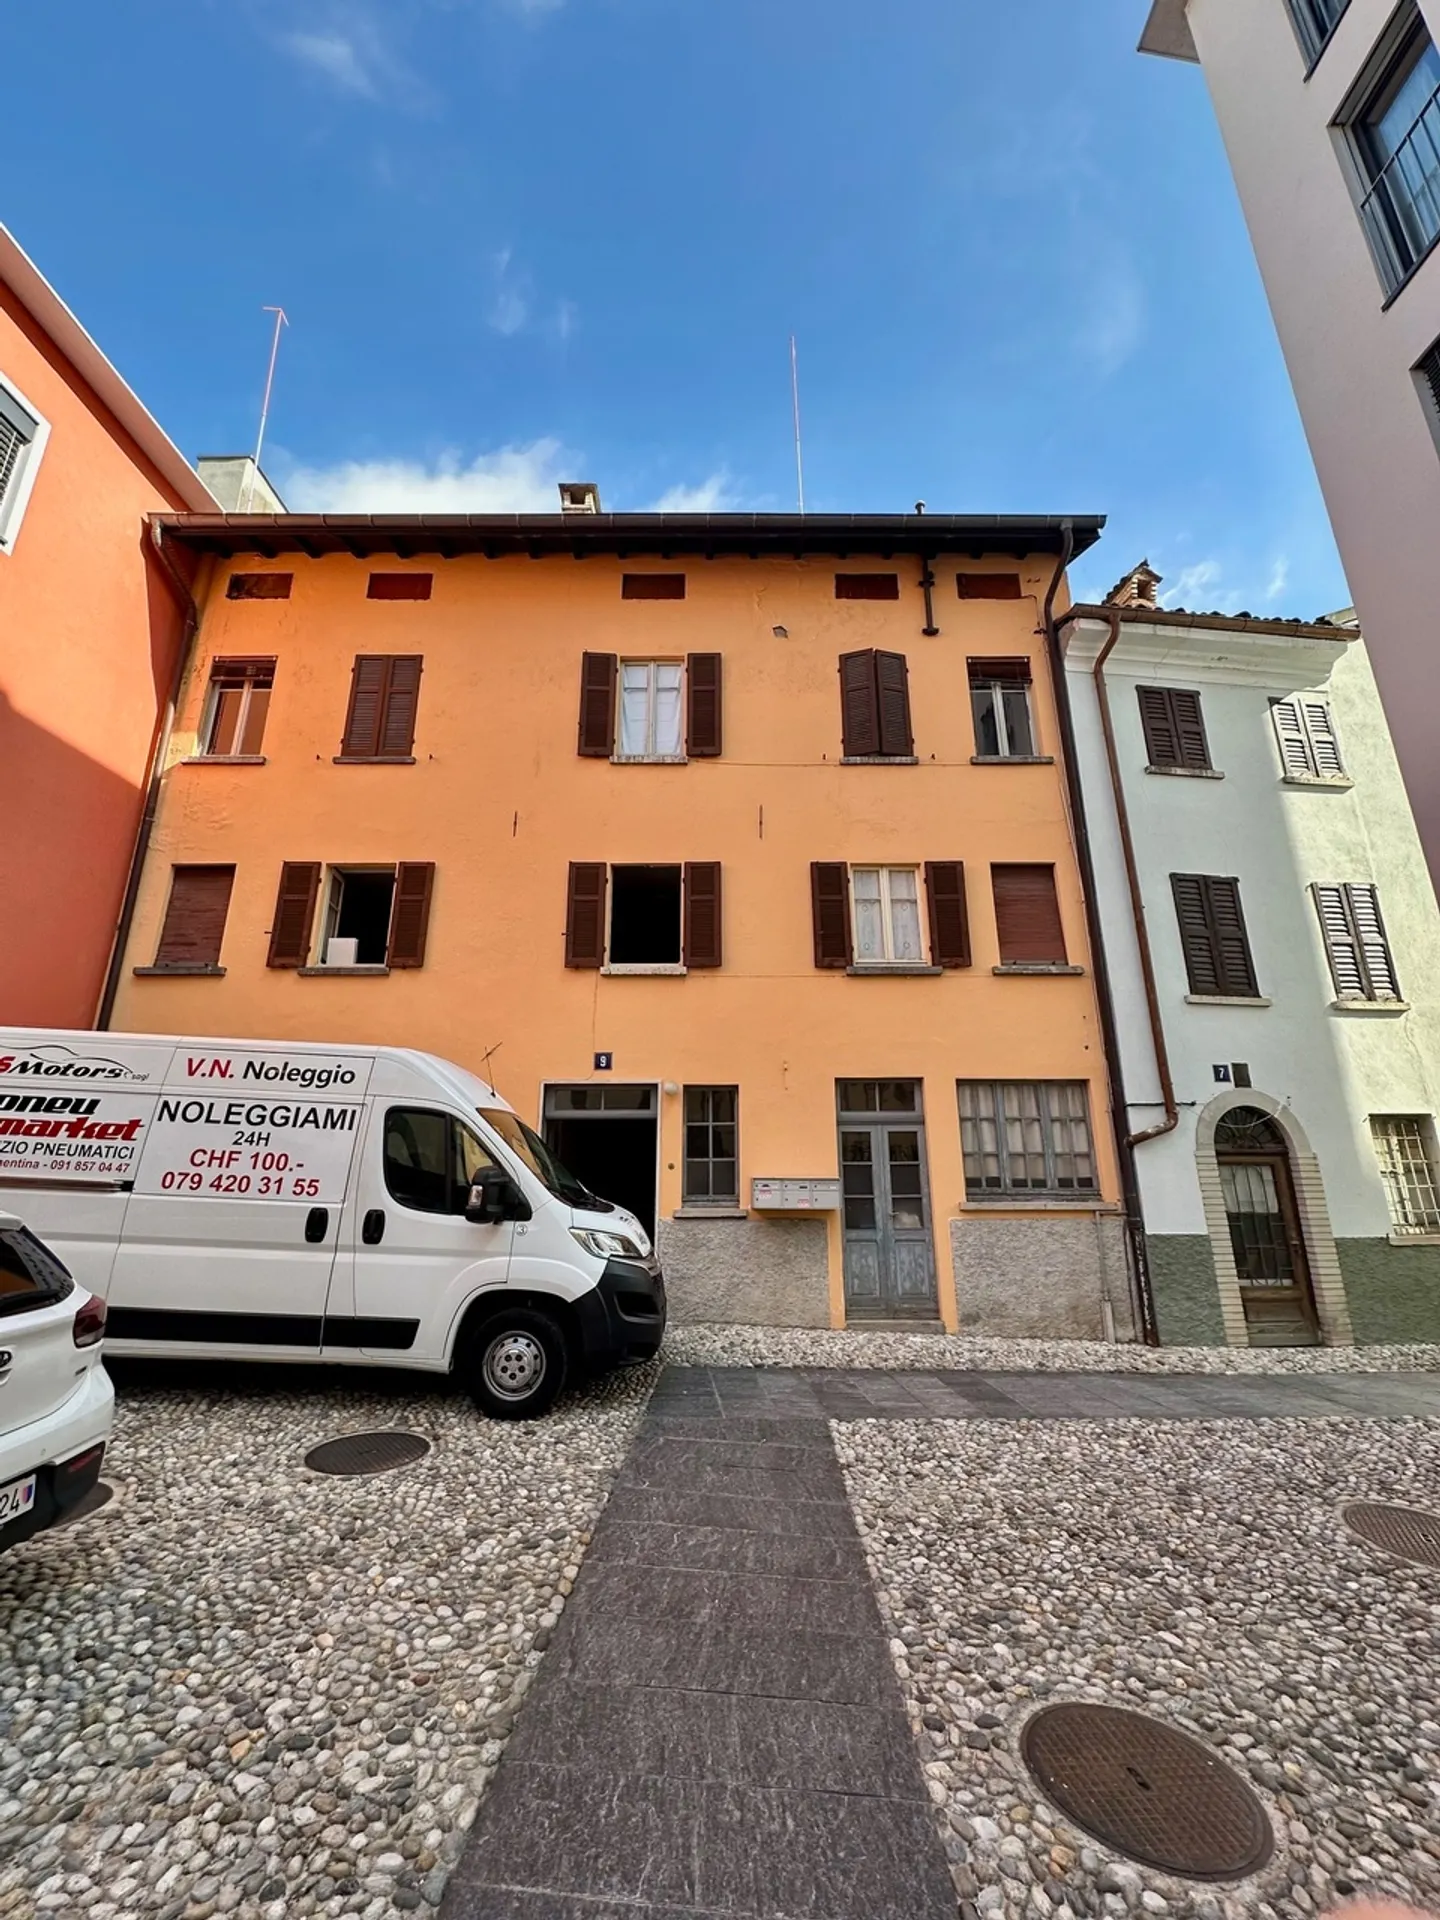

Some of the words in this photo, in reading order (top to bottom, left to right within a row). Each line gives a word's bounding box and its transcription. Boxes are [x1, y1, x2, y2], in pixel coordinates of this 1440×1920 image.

[599, 1055, 607, 1068] 9
[187, 1058, 234, 1078] V.N.
[242, 1061, 355, 1088] Noleggio
[157, 1100, 357, 1131] NOLEGGIAMI
[232, 1131, 271, 1147] 24H
[32, 1141, 135, 1160] PNEUMATICI
[190, 1149, 242, 1169] CHF
[249, 1152, 304, 1173] 100.-
[0, 1158, 40, 1170] entina
[50, 1159, 71, 1171] 091
[74, 1160, 96, 1172] 857
[98, 1162, 113, 1173] 04
[115, 1163, 130, 1174] 47
[161, 1171, 203, 1191] 079
[209, 1174, 251, 1193] 420
[257, 1176, 284, 1196] 31
[292, 1178, 320, 1197] 55
